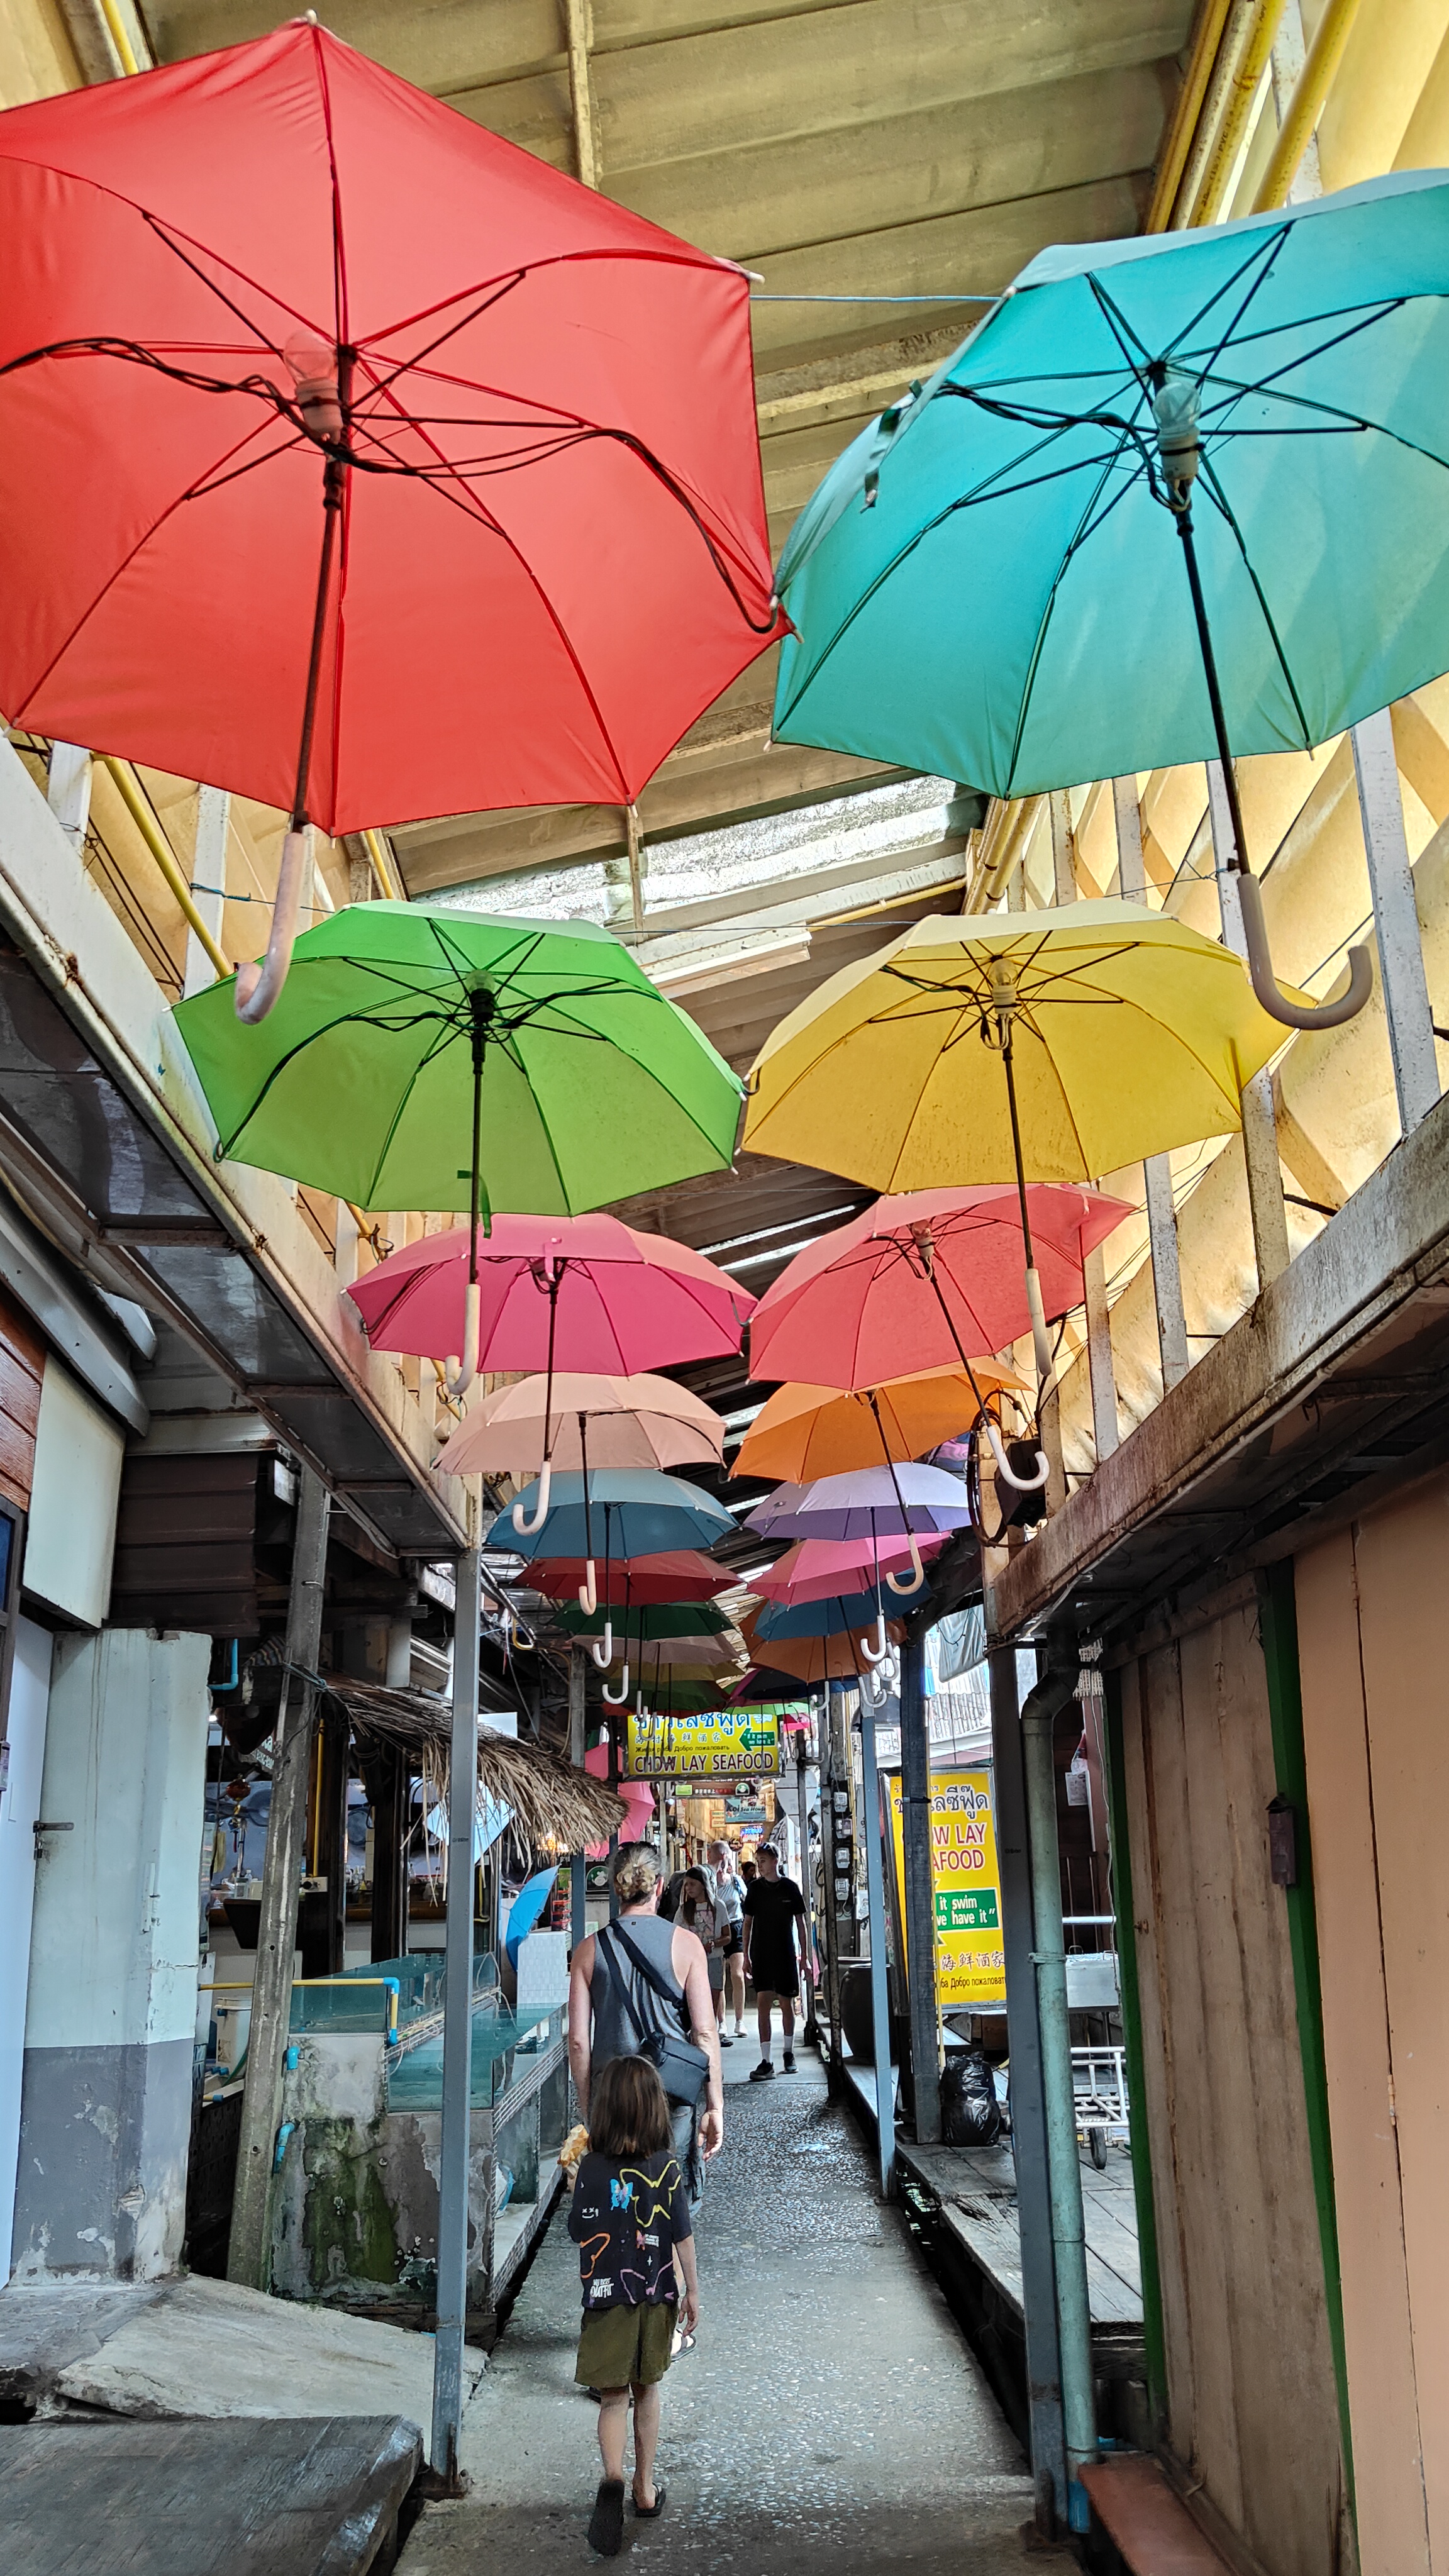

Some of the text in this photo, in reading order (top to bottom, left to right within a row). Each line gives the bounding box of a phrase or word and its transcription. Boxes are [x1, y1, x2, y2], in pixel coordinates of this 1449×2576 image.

[635, 1752, 774, 1773] CHOW LAY SEAFOOD
[955, 1823, 985, 1845] LAY
[933, 1849, 984, 1871] AFOOD
[939, 1894, 978, 1911] it swim
[951, 1910, 975, 1926] have
[950, 1976, 970, 1990] Добро
[972, 1976, 1005, 1986] пожаловат
[589, 2283, 614, 2299] OUTFIT
